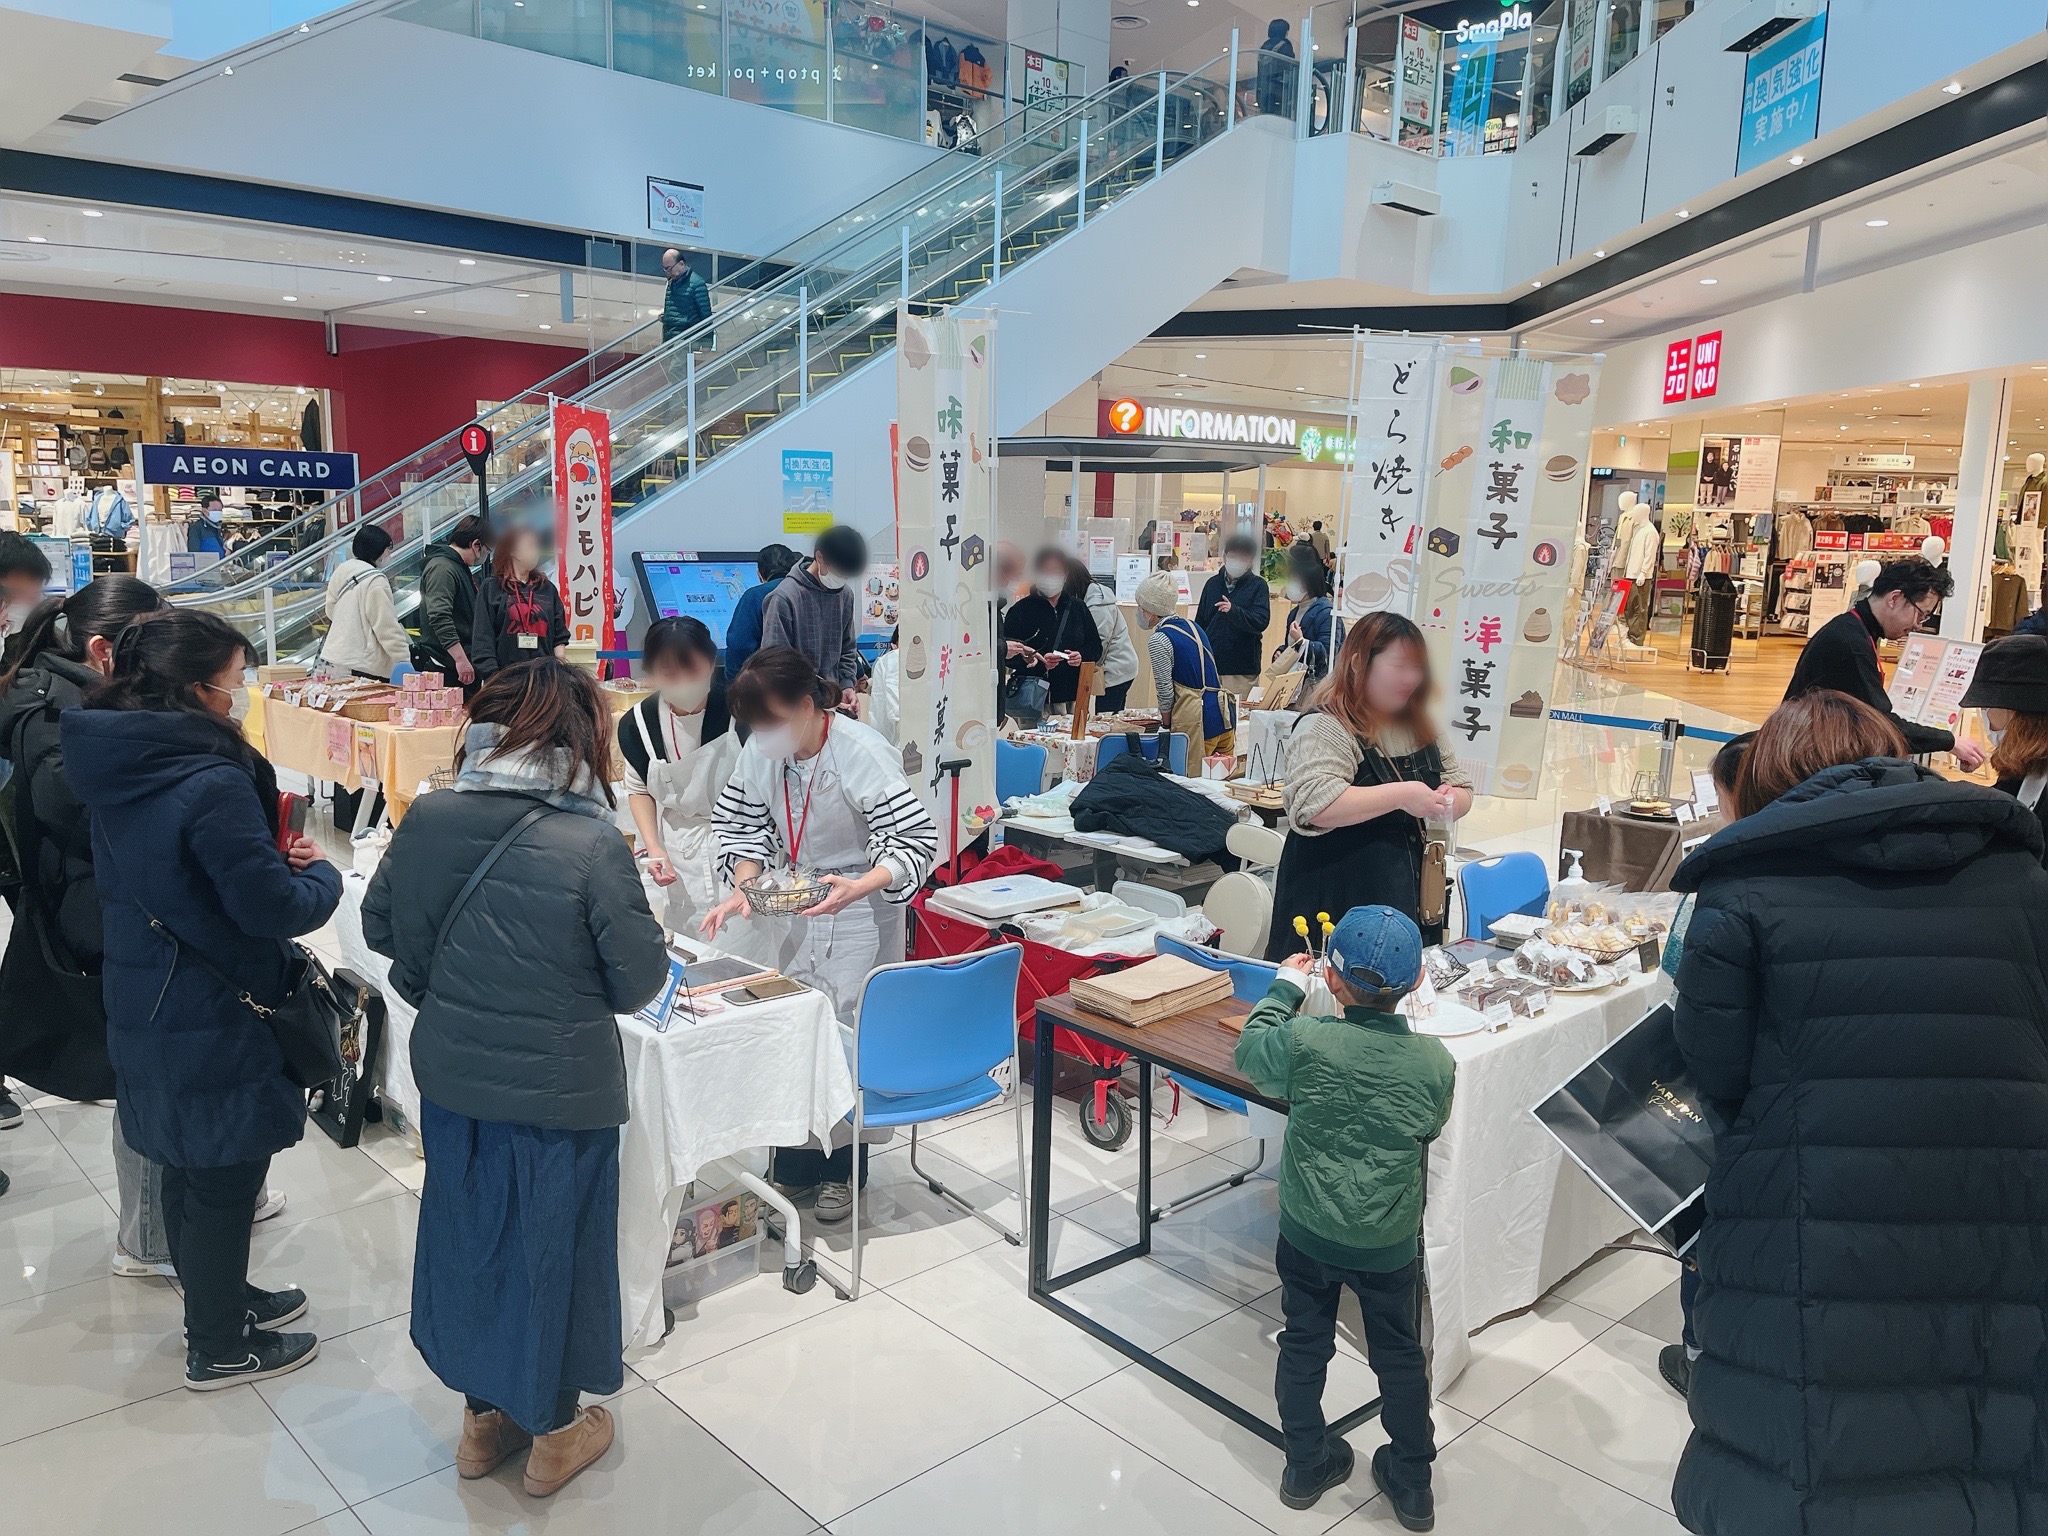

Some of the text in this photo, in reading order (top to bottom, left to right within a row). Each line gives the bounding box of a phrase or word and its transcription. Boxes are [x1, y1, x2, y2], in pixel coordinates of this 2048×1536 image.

[1027, 54, 1042, 69] 本日
[1416, 47, 1424, 59] 10
[1042, 77, 1051, 88] 10
[1755, 47, 1820, 109] 換気強化
[1694, 366, 1716, 394] QLO
[1145, 406, 1297, 446] INFORMATION
[173, 456, 331, 479] AEON CARD
[1372, 360, 1416, 541] どら焼き
[1476, 418, 1533, 551] 和菓子
[572, 493, 599, 618] ジモハピ
[1432, 565, 1549, 603] Sweets
[1451, 614, 1503, 742] 洋菓子
[1561, 711, 1584, 723] MALL
